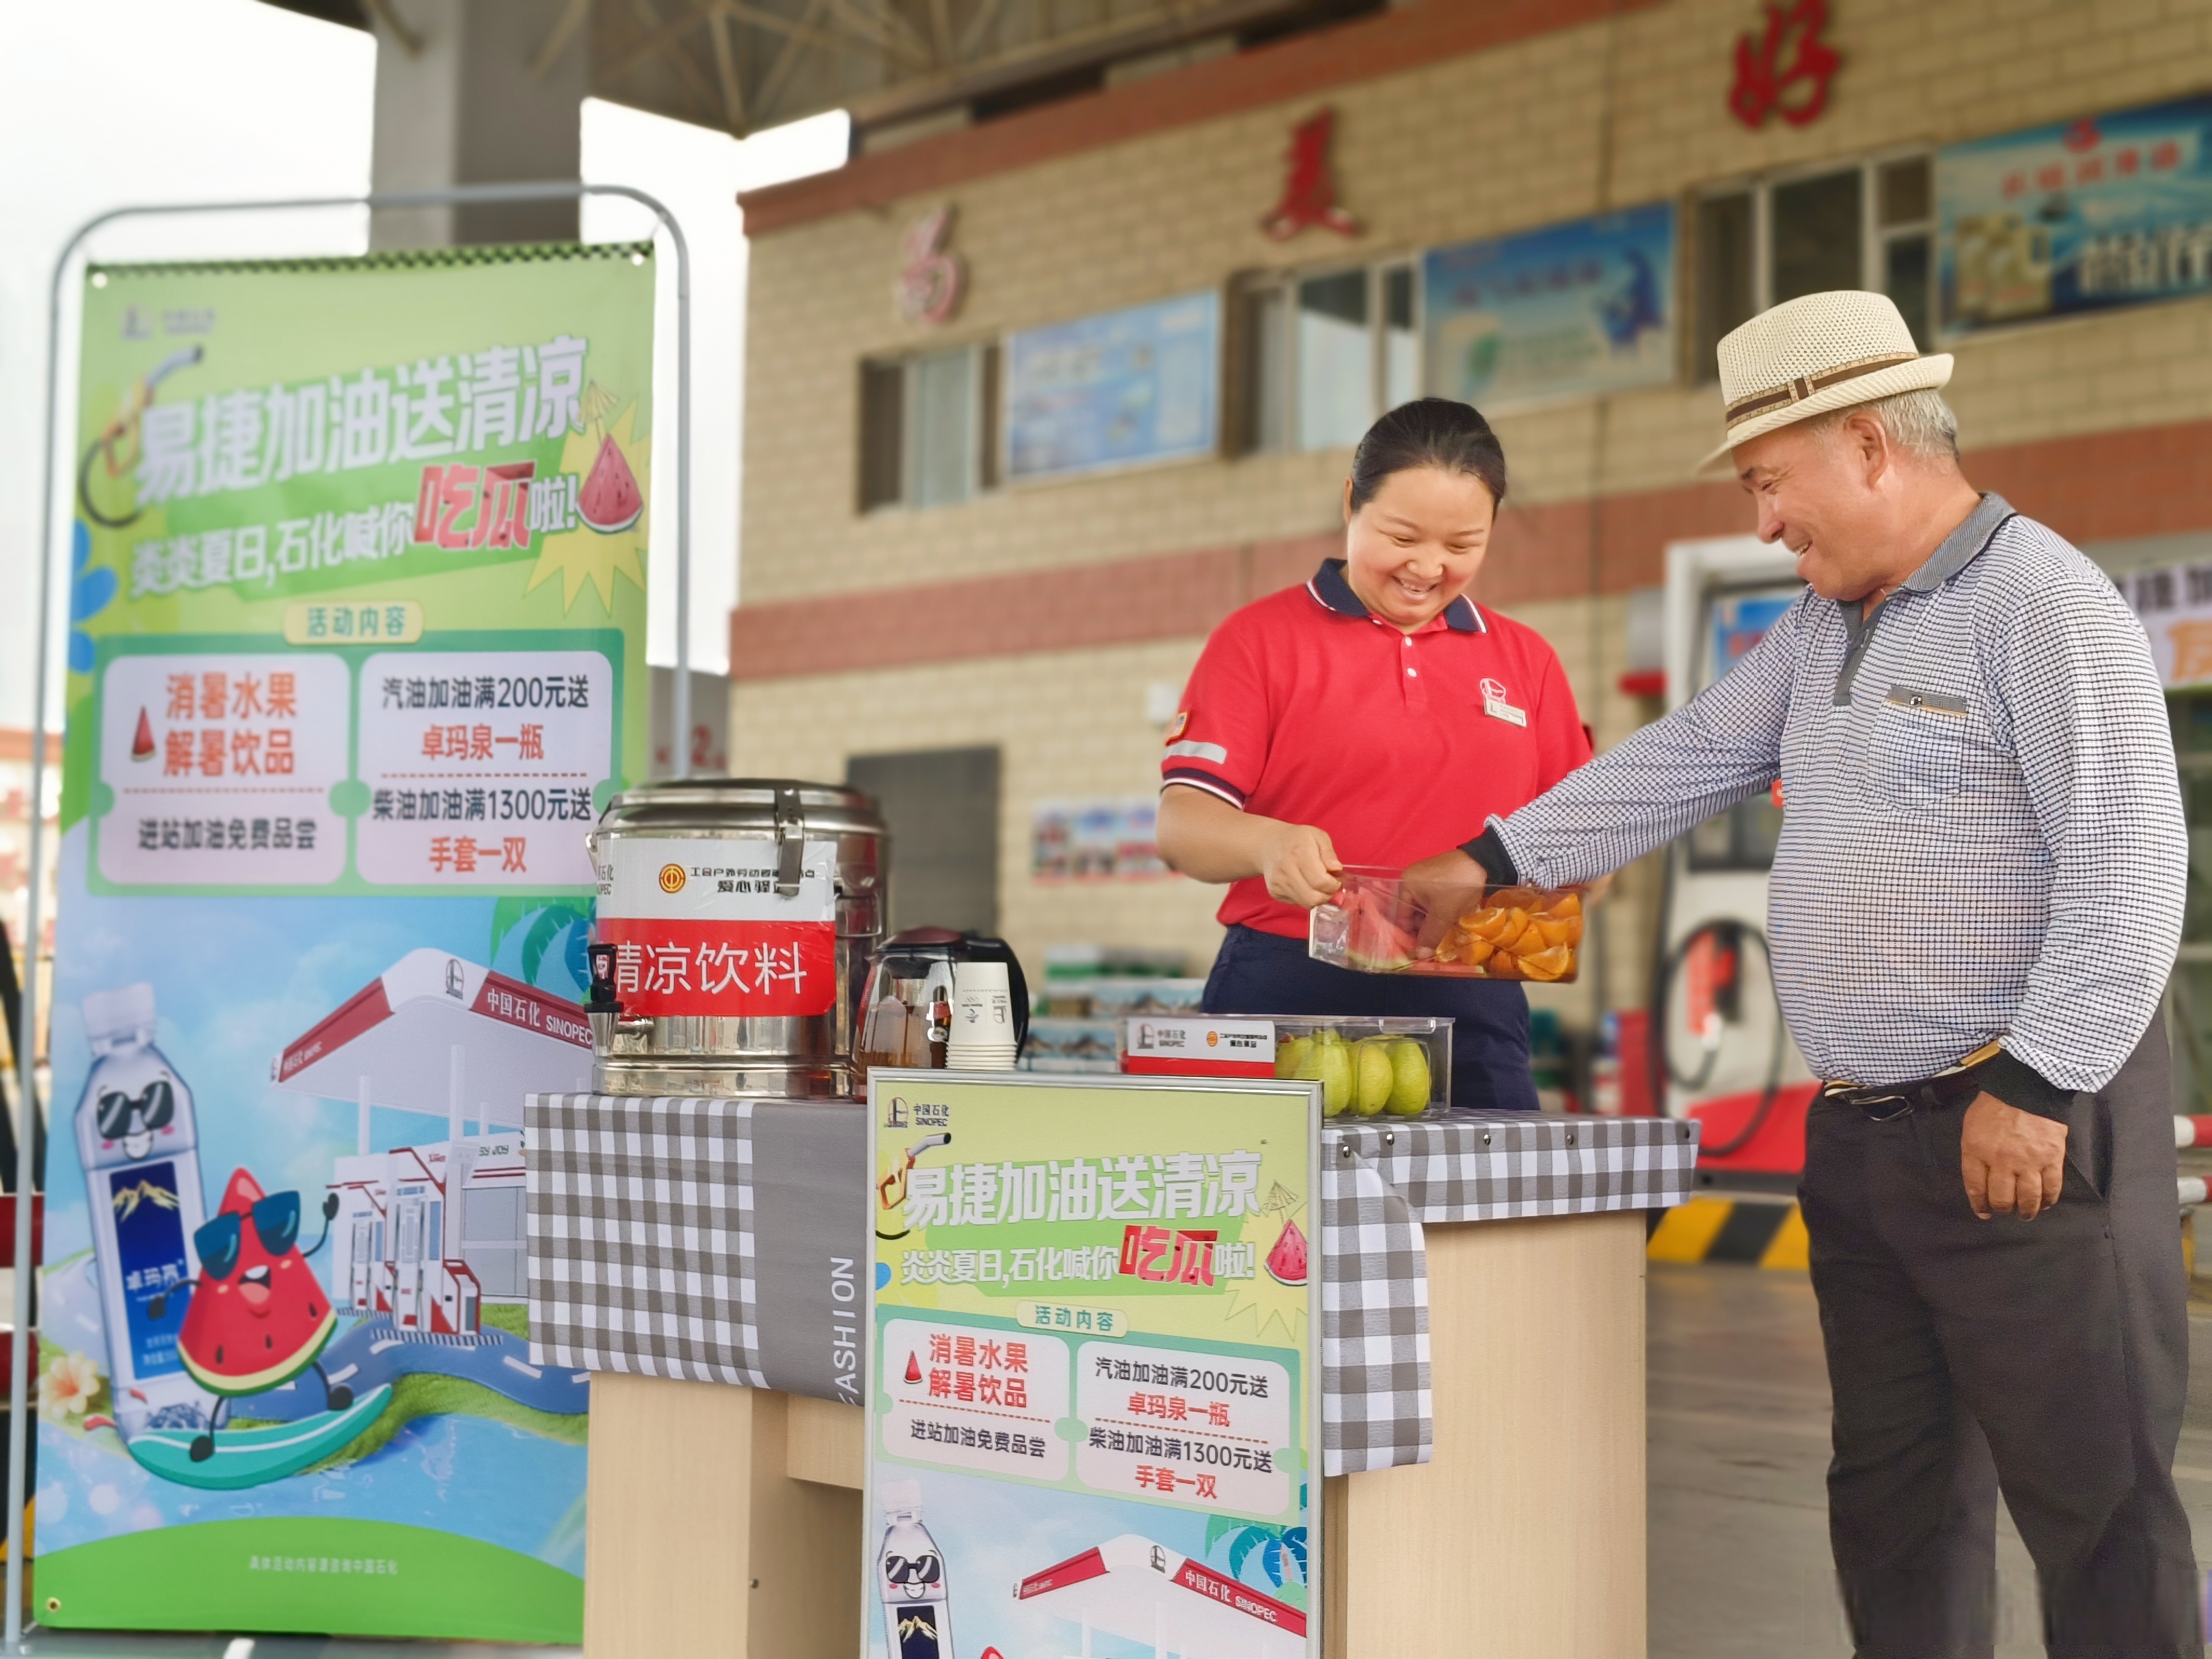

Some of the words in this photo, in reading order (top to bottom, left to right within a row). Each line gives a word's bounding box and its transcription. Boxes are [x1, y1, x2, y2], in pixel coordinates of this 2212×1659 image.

[136, 335, 589, 504] 易捷加油送清凉
[306, 606, 406, 638] 活动内容
[166, 672, 296, 720] 消暑水果
[382, 675, 589, 711] 汽油加油满200元送
[163, 729, 295, 777] 解暑饮品
[422, 724, 544, 760] 卓玛泉一瓶
[373, 787, 592, 821] 柴油加油满1300元送
[138, 818, 317, 852] 进站加油免费品尝
[429, 835, 527, 873] 手套一双
[487, 988, 541, 1028] 中国石化
[546, 1015, 594, 1045] SINOPEC
[913, 1103, 949, 1117] 中国石化
[902, 1149, 1262, 1228] 易捷加油送清凉
[1034, 1304, 1114, 1332] 活动内容
[929, 1333, 1029, 1374] 消暑水果
[928, 1366, 1027, 1408] 解暑饮品
[1095, 1355, 1269, 1399] 汽油加油满200元送
[1128, 1391, 1230, 1427] 卓玛泉一瓶
[911, 1418, 1047, 1458] 进站加油免费品尝
[1088, 1426, 1273, 1474] 柴油加油满1300元送
[1135, 1465, 1218, 1500] 手套一双
[1185, 1569, 1231, 1602] 中国石化
